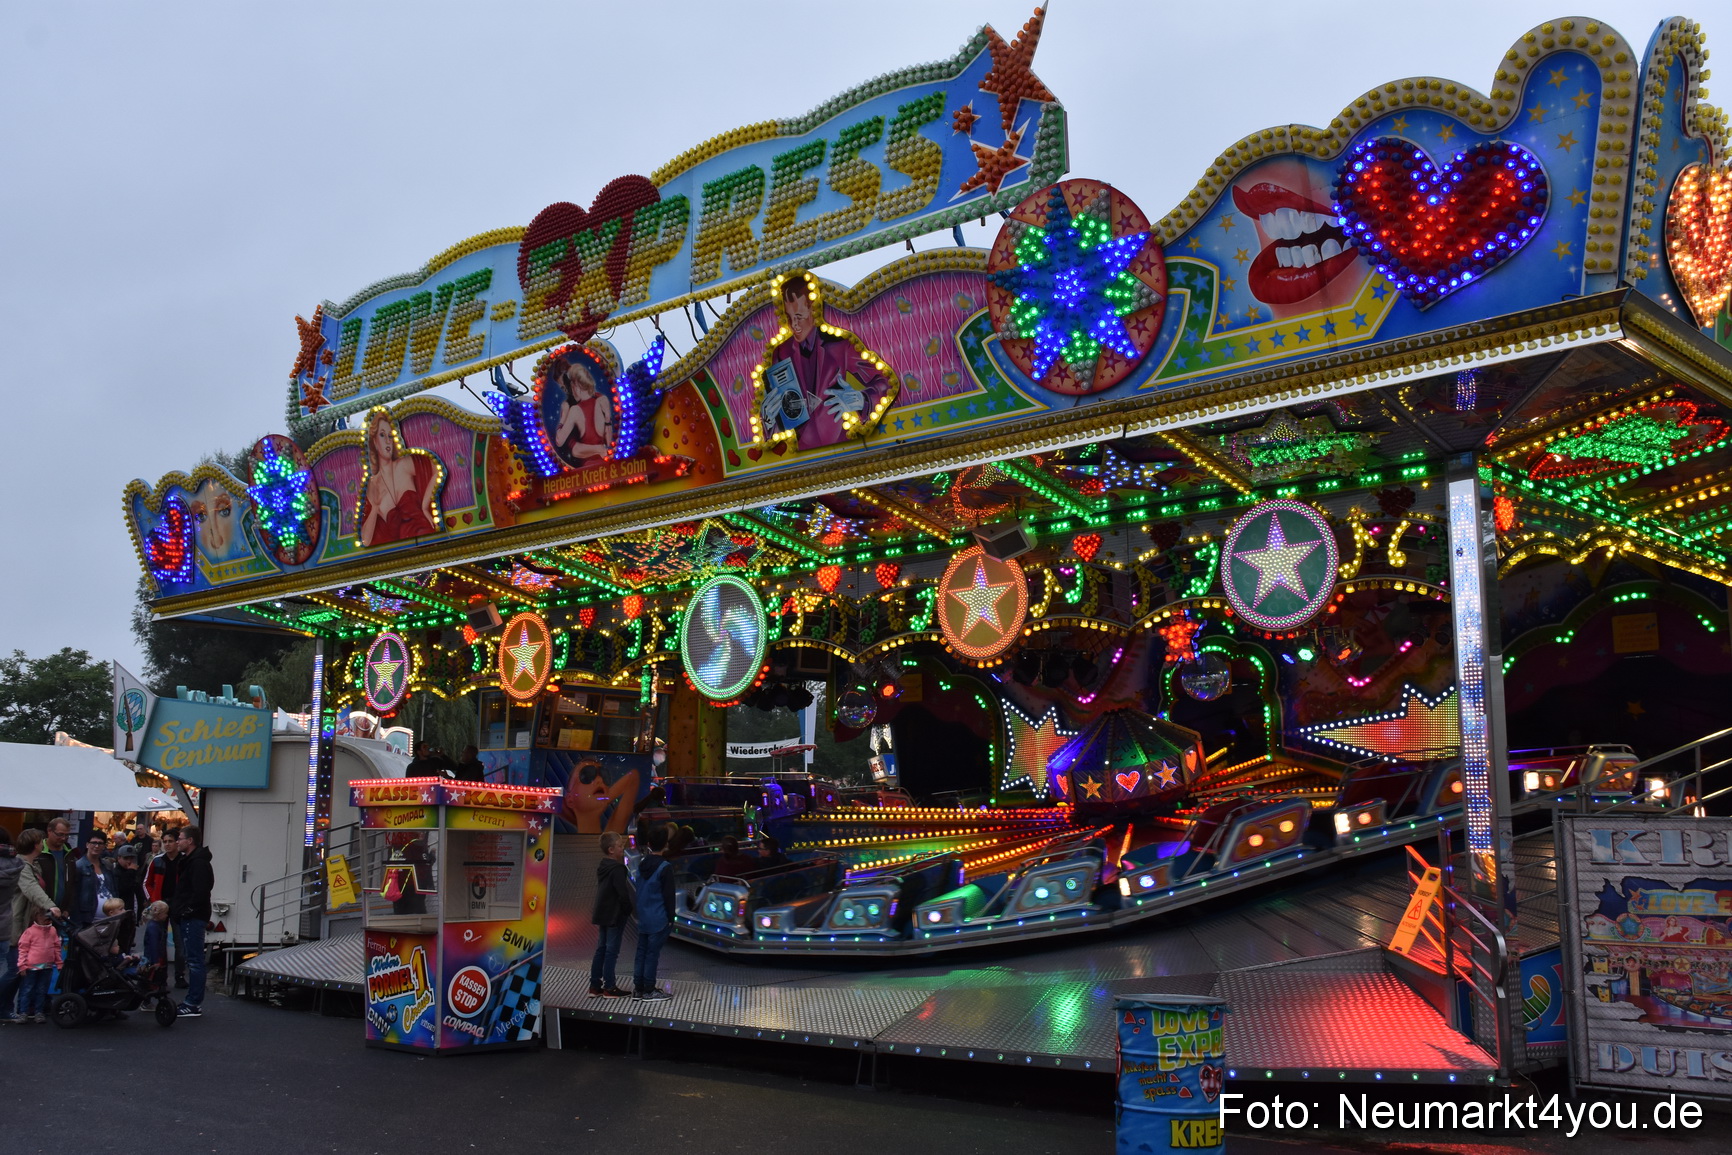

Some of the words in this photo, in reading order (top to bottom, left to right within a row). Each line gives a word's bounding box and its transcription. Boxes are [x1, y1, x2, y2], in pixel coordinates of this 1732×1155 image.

[329, 90, 947, 401] LOVE-EXPRESS
[543, 474, 580, 494] Herbert
[583, 467, 608, 485] Kreft
[610, 465, 618, 478] &
[620, 459, 647, 476] Sohn
[154, 715, 264, 747] Schieß-
[160, 742, 262, 770] Centrum
[730, 744, 784, 755] Wiederseh
[369, 786, 419, 801] KASSE
[464, 790, 539, 810] KASSE
[393, 808, 426, 826] COMPAQ
[472, 809, 506, 828] Ferrari
[1586, 828, 1732, 867] KR
[471, 901, 486, 910] BMW
[367, 937, 387, 954] Ferrari
[503, 928, 536, 953] BMW
[368, 966, 415, 1001] FORMEL
[411, 947, 431, 1001] 1
[459, 974, 487, 997] KASSEN
[455, 989, 478, 1009] STOP
[367, 1007, 391, 1037] BMW
[443, 1015, 485, 1038] COMPAQ
[495, 999, 540, 1038] Mercedes
[1152, 1009, 1210, 1037] LOVE
[1157, 1026, 1225, 1072] EXPR
[1138, 1073, 1167, 1086] macht
[1143, 1086, 1177, 1102] spass
